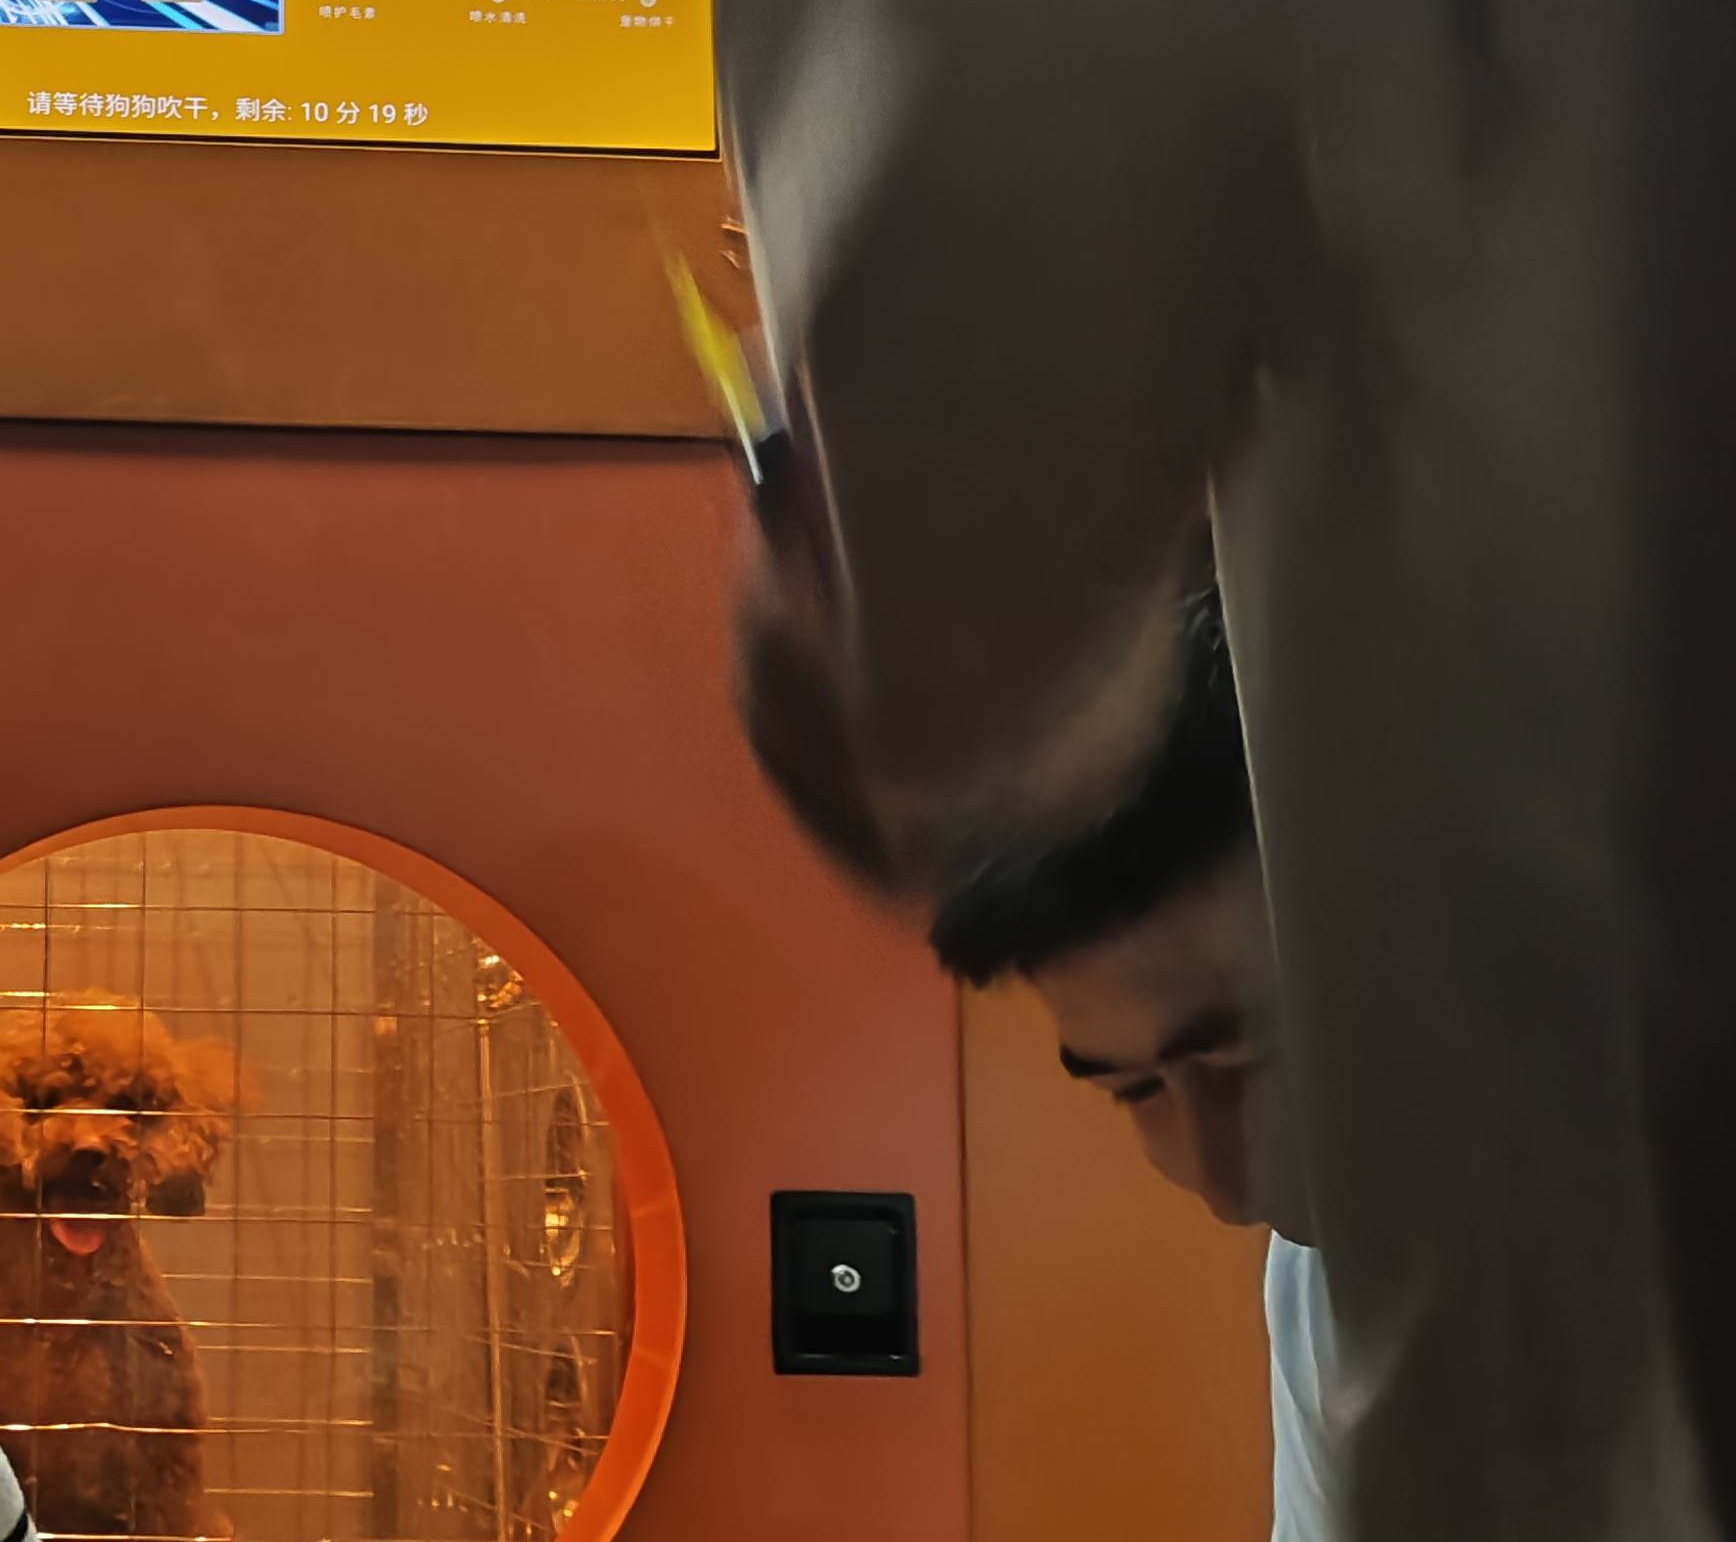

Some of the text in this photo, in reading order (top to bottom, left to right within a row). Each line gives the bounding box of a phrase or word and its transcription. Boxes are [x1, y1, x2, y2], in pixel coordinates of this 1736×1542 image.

[301, 102, 329, 123] 10
[336, 101, 361, 125] 分
[369, 103, 397, 124] 19
[403, 102, 429, 126] 秒
